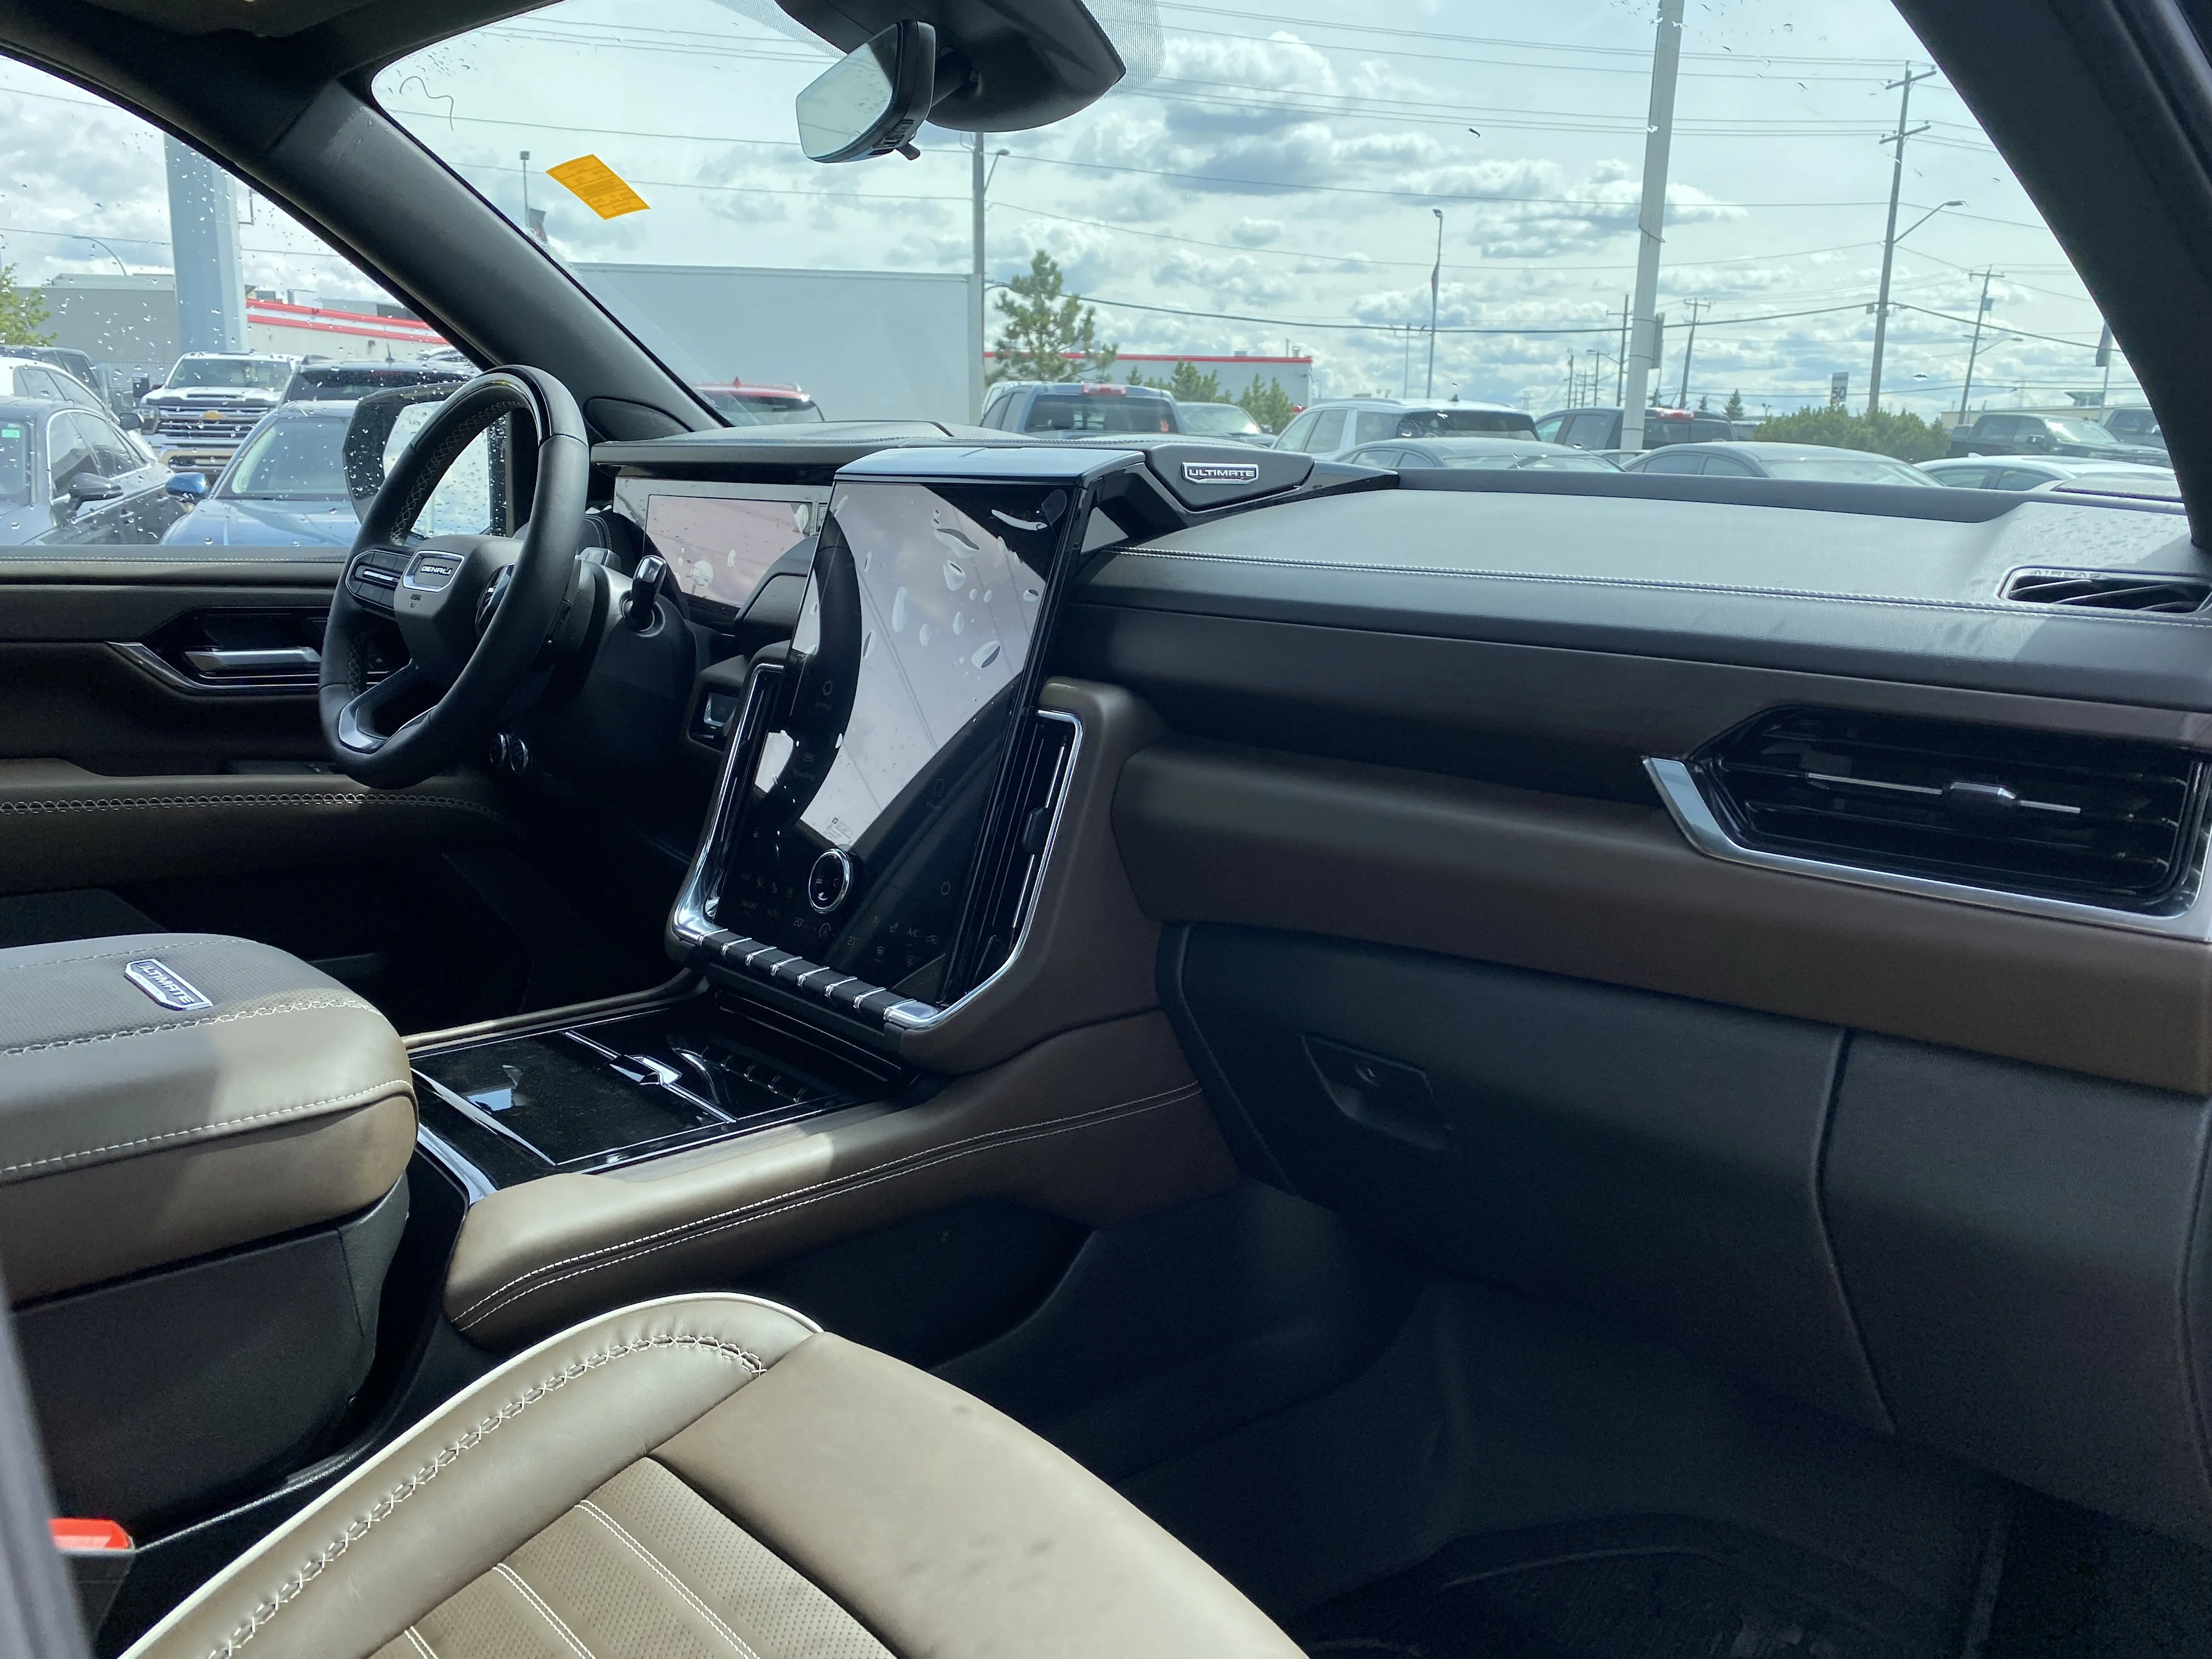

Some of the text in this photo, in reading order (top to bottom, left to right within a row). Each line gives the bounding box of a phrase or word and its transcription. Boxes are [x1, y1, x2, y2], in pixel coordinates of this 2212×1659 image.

[1832, 386, 1847, 399] 50
[421, 566, 452, 574] DENALI
[137, 962, 195, 1004] ULTIMATE
